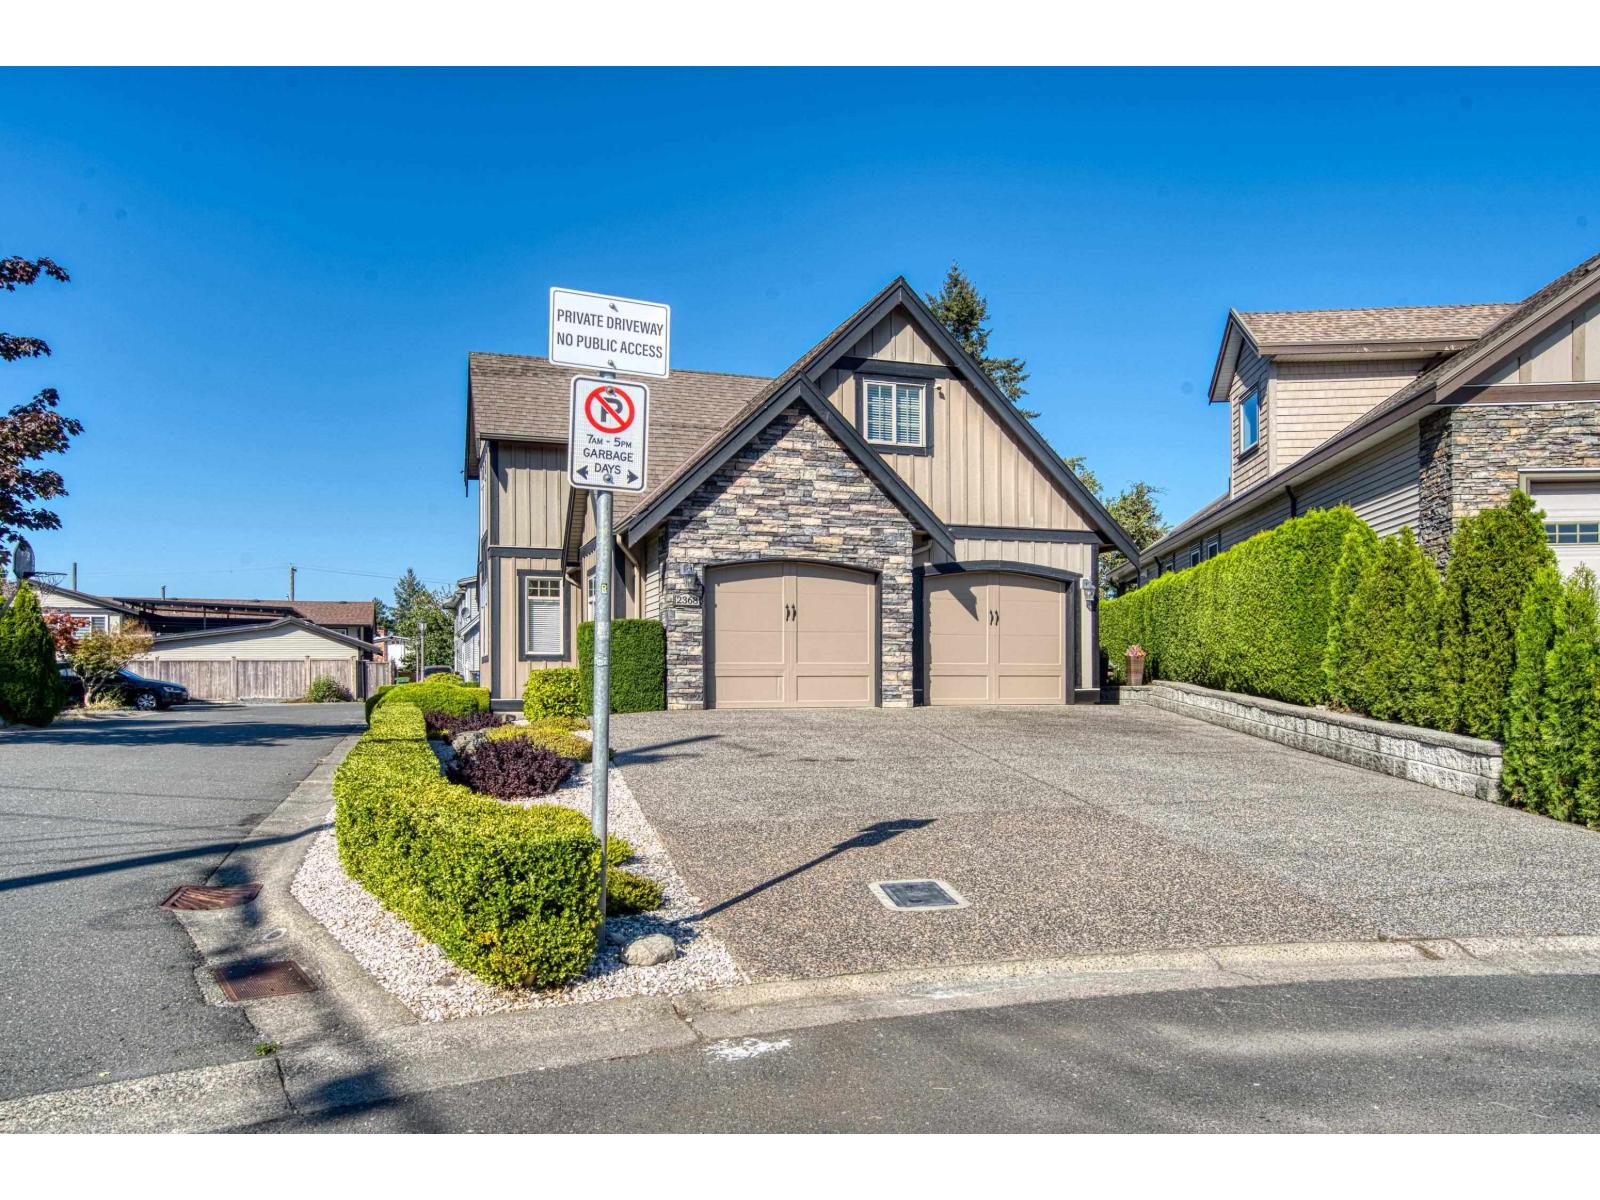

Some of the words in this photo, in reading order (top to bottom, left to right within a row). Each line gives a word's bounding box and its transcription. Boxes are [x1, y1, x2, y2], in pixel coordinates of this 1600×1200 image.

[557, 309, 604, 328] PRIVATE
[606, 316, 664, 337] DRIVEWAY
[557, 332, 573, 347] NO
[576, 335, 618, 353] PUBLIC
[620, 341, 663, 359] ACCESS
[583, 447, 634, 463] GARBAGE
[594, 462, 621, 475] DAYS
